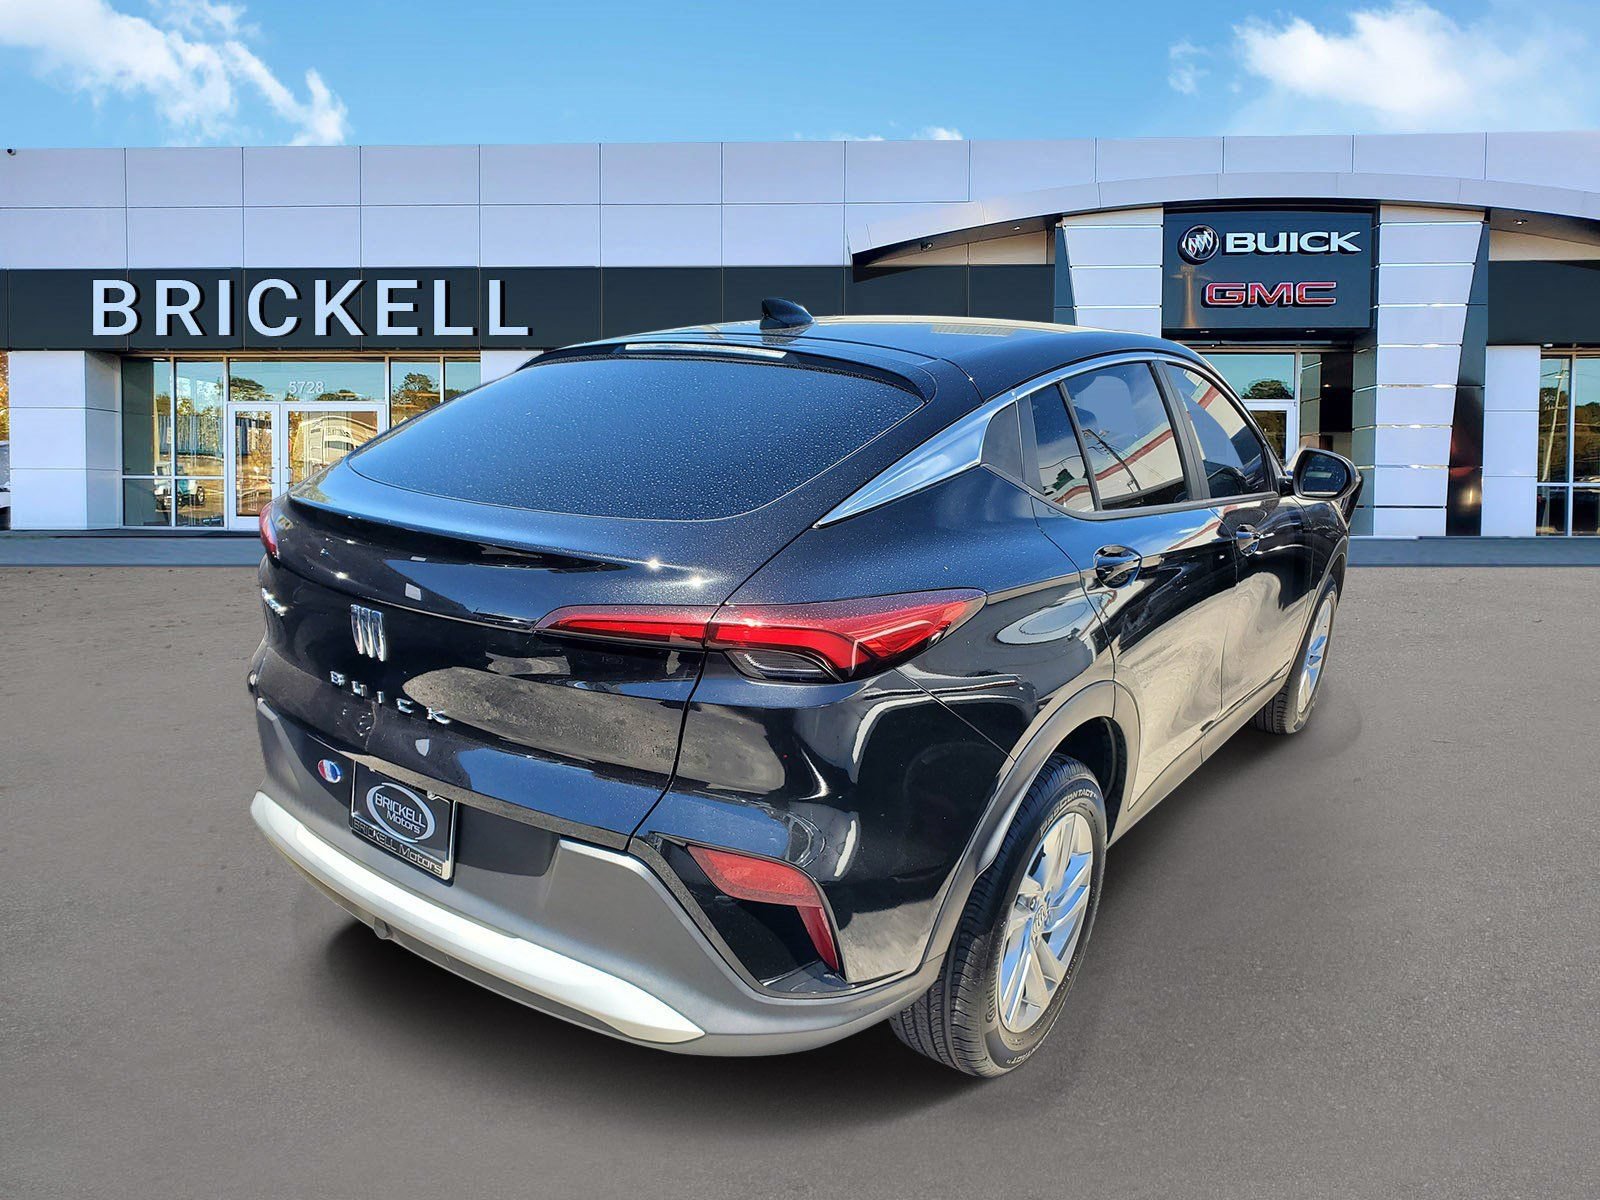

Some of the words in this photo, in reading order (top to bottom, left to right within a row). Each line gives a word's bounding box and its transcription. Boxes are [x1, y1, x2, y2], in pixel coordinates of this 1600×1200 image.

[1226, 231, 1362, 253] BUICK
[92, 278, 530, 337] BRICKELL
[1206, 281, 1337, 305] GMC
[288, 380, 325, 394] 5728
[329, 670, 452, 724] BUICK
[375, 792, 426, 828] BRICKELL
[386, 810, 421, 834] Motors
[352, 818, 397, 851] BRICKELL
[399, 844, 442, 875] Motors
